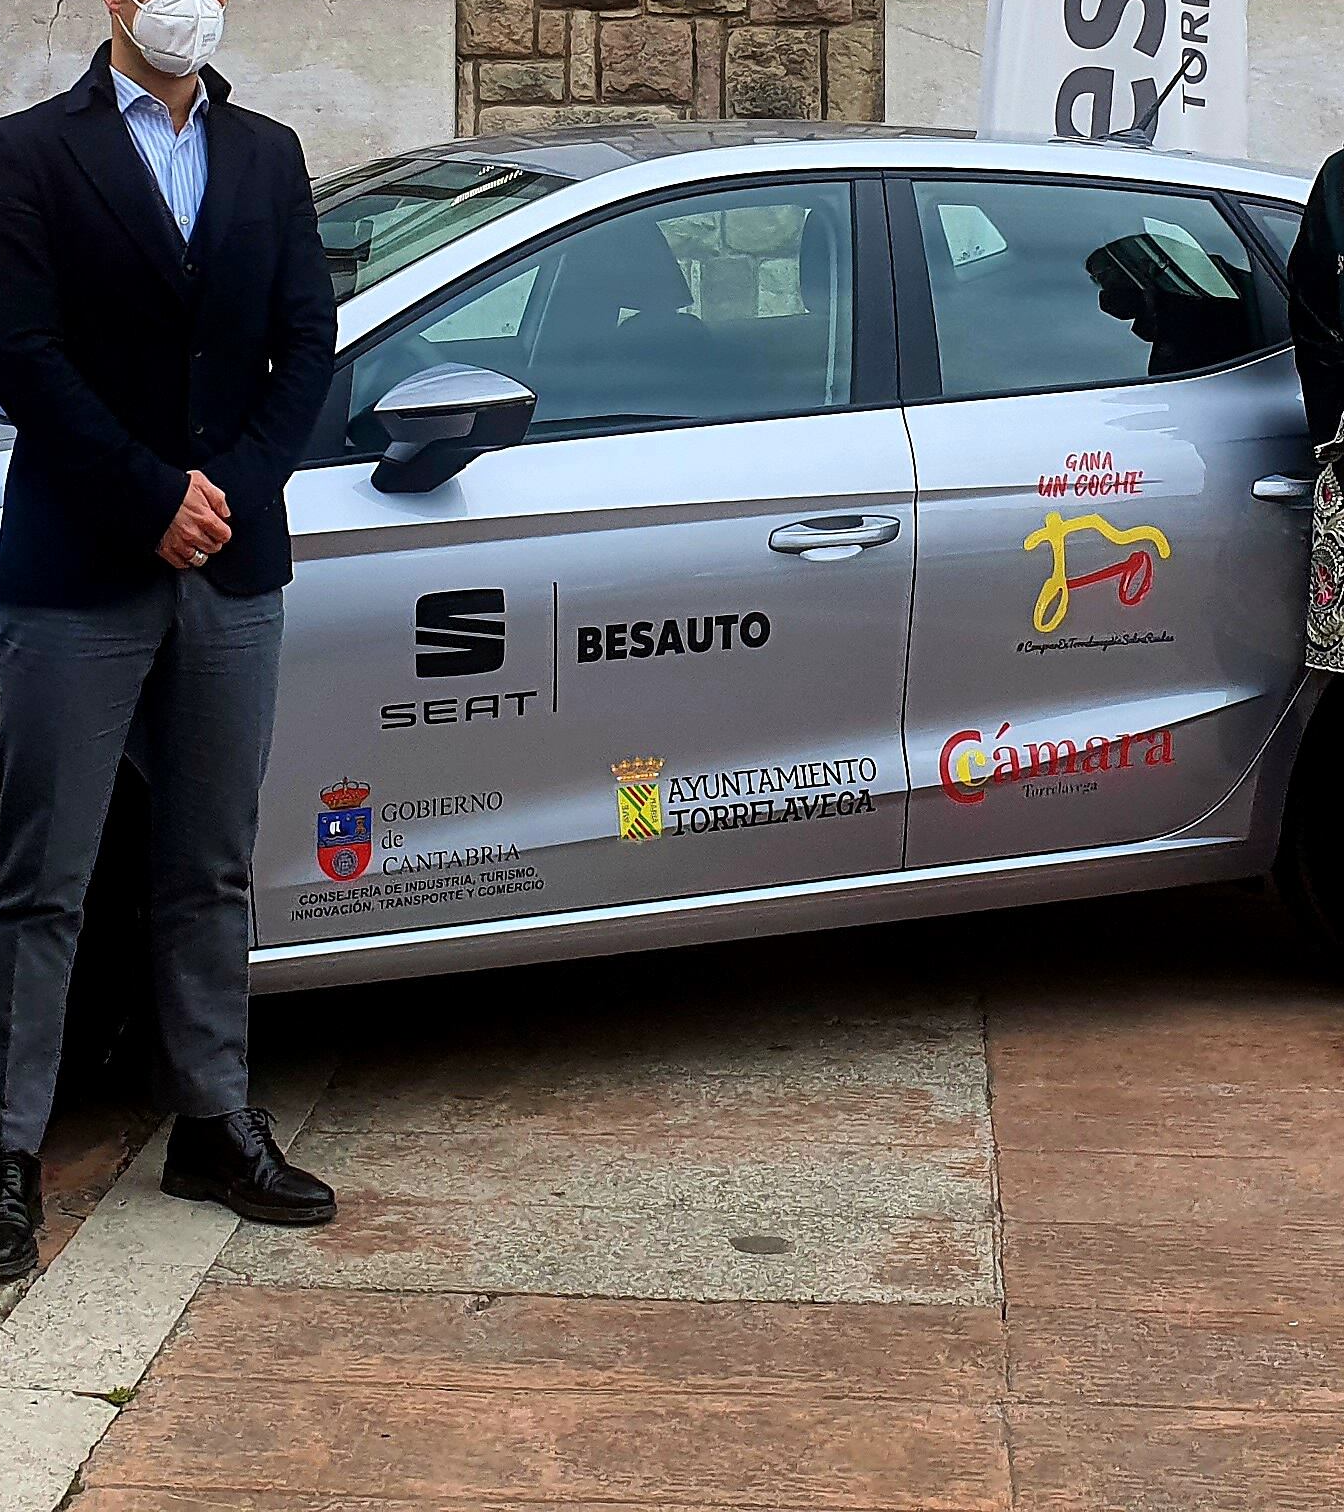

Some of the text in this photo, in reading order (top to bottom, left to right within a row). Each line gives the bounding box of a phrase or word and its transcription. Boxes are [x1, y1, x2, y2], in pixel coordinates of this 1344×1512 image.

[1065, 450, 1113, 472] GANA
[1038, 470, 1144, 497] UN COCHE
[577, 611, 771, 664] BESAUTO
[380, 690, 538, 730] SEAT
[668, 757, 877, 804] AYUNTAMIENTO
[939, 721, 1176, 804] Cámara
[381, 791, 503, 822] GOBIERNO
[1022, 780, 1098, 799] Torrelavega
[668, 789, 877, 837] TORRELAVEGA
[381, 830, 404, 849] de
[382, 843, 522, 876] CANTABRIA
[291, 879, 545, 922] INNOVACIÓN, TRANSPORTE Y COMERCIO
[299, 866, 538, 906] CONSEJERÍA DE INDUSTRIA, TURISMO,
